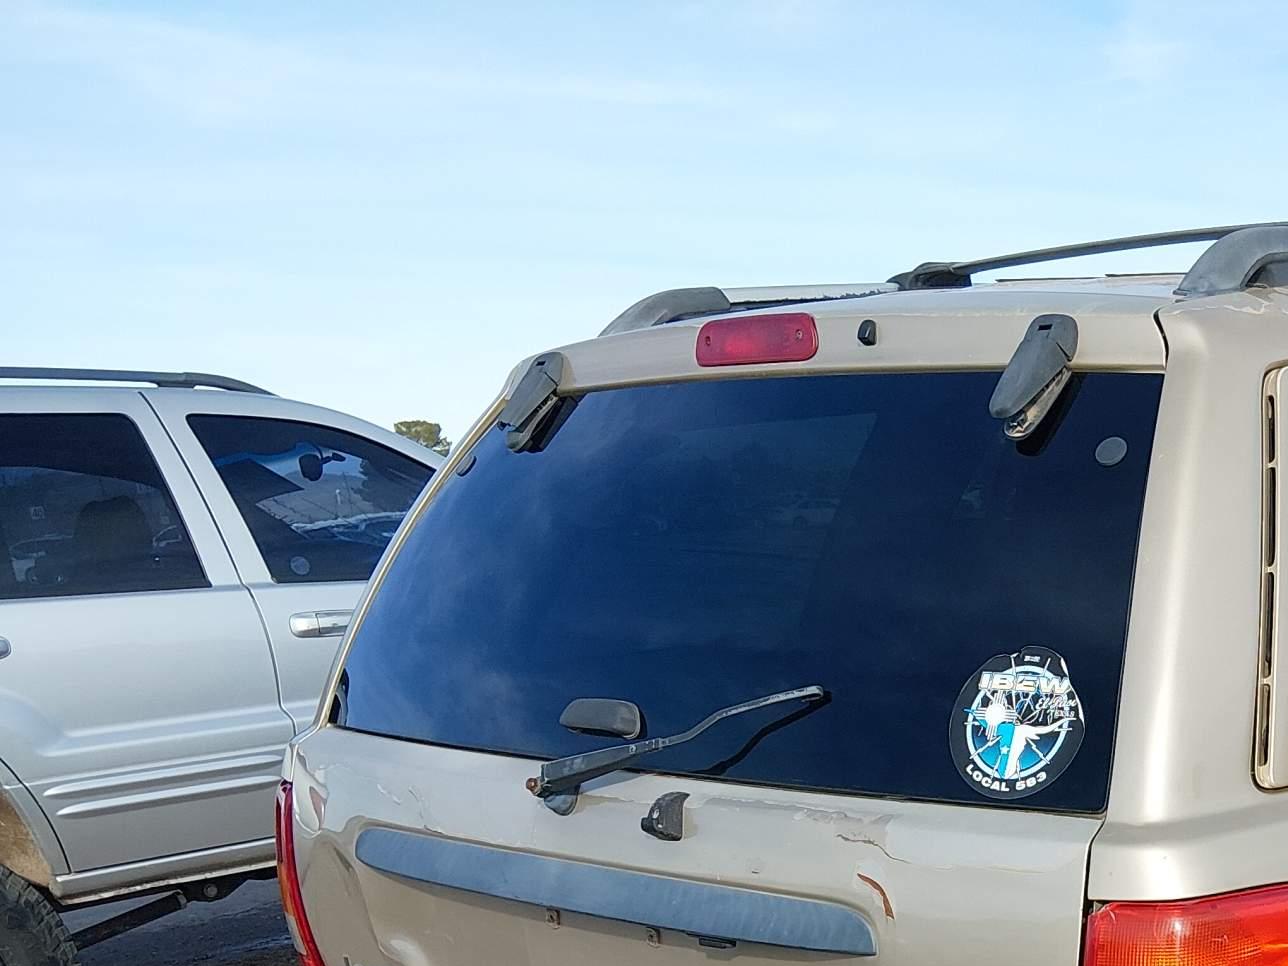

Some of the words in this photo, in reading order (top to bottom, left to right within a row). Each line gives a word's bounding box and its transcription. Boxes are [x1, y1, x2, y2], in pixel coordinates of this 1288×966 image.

[978, 671, 1071, 694] IBEW
[966, 763, 1010, 792] LOCAL
[1015, 771, 1047, 791] 583
